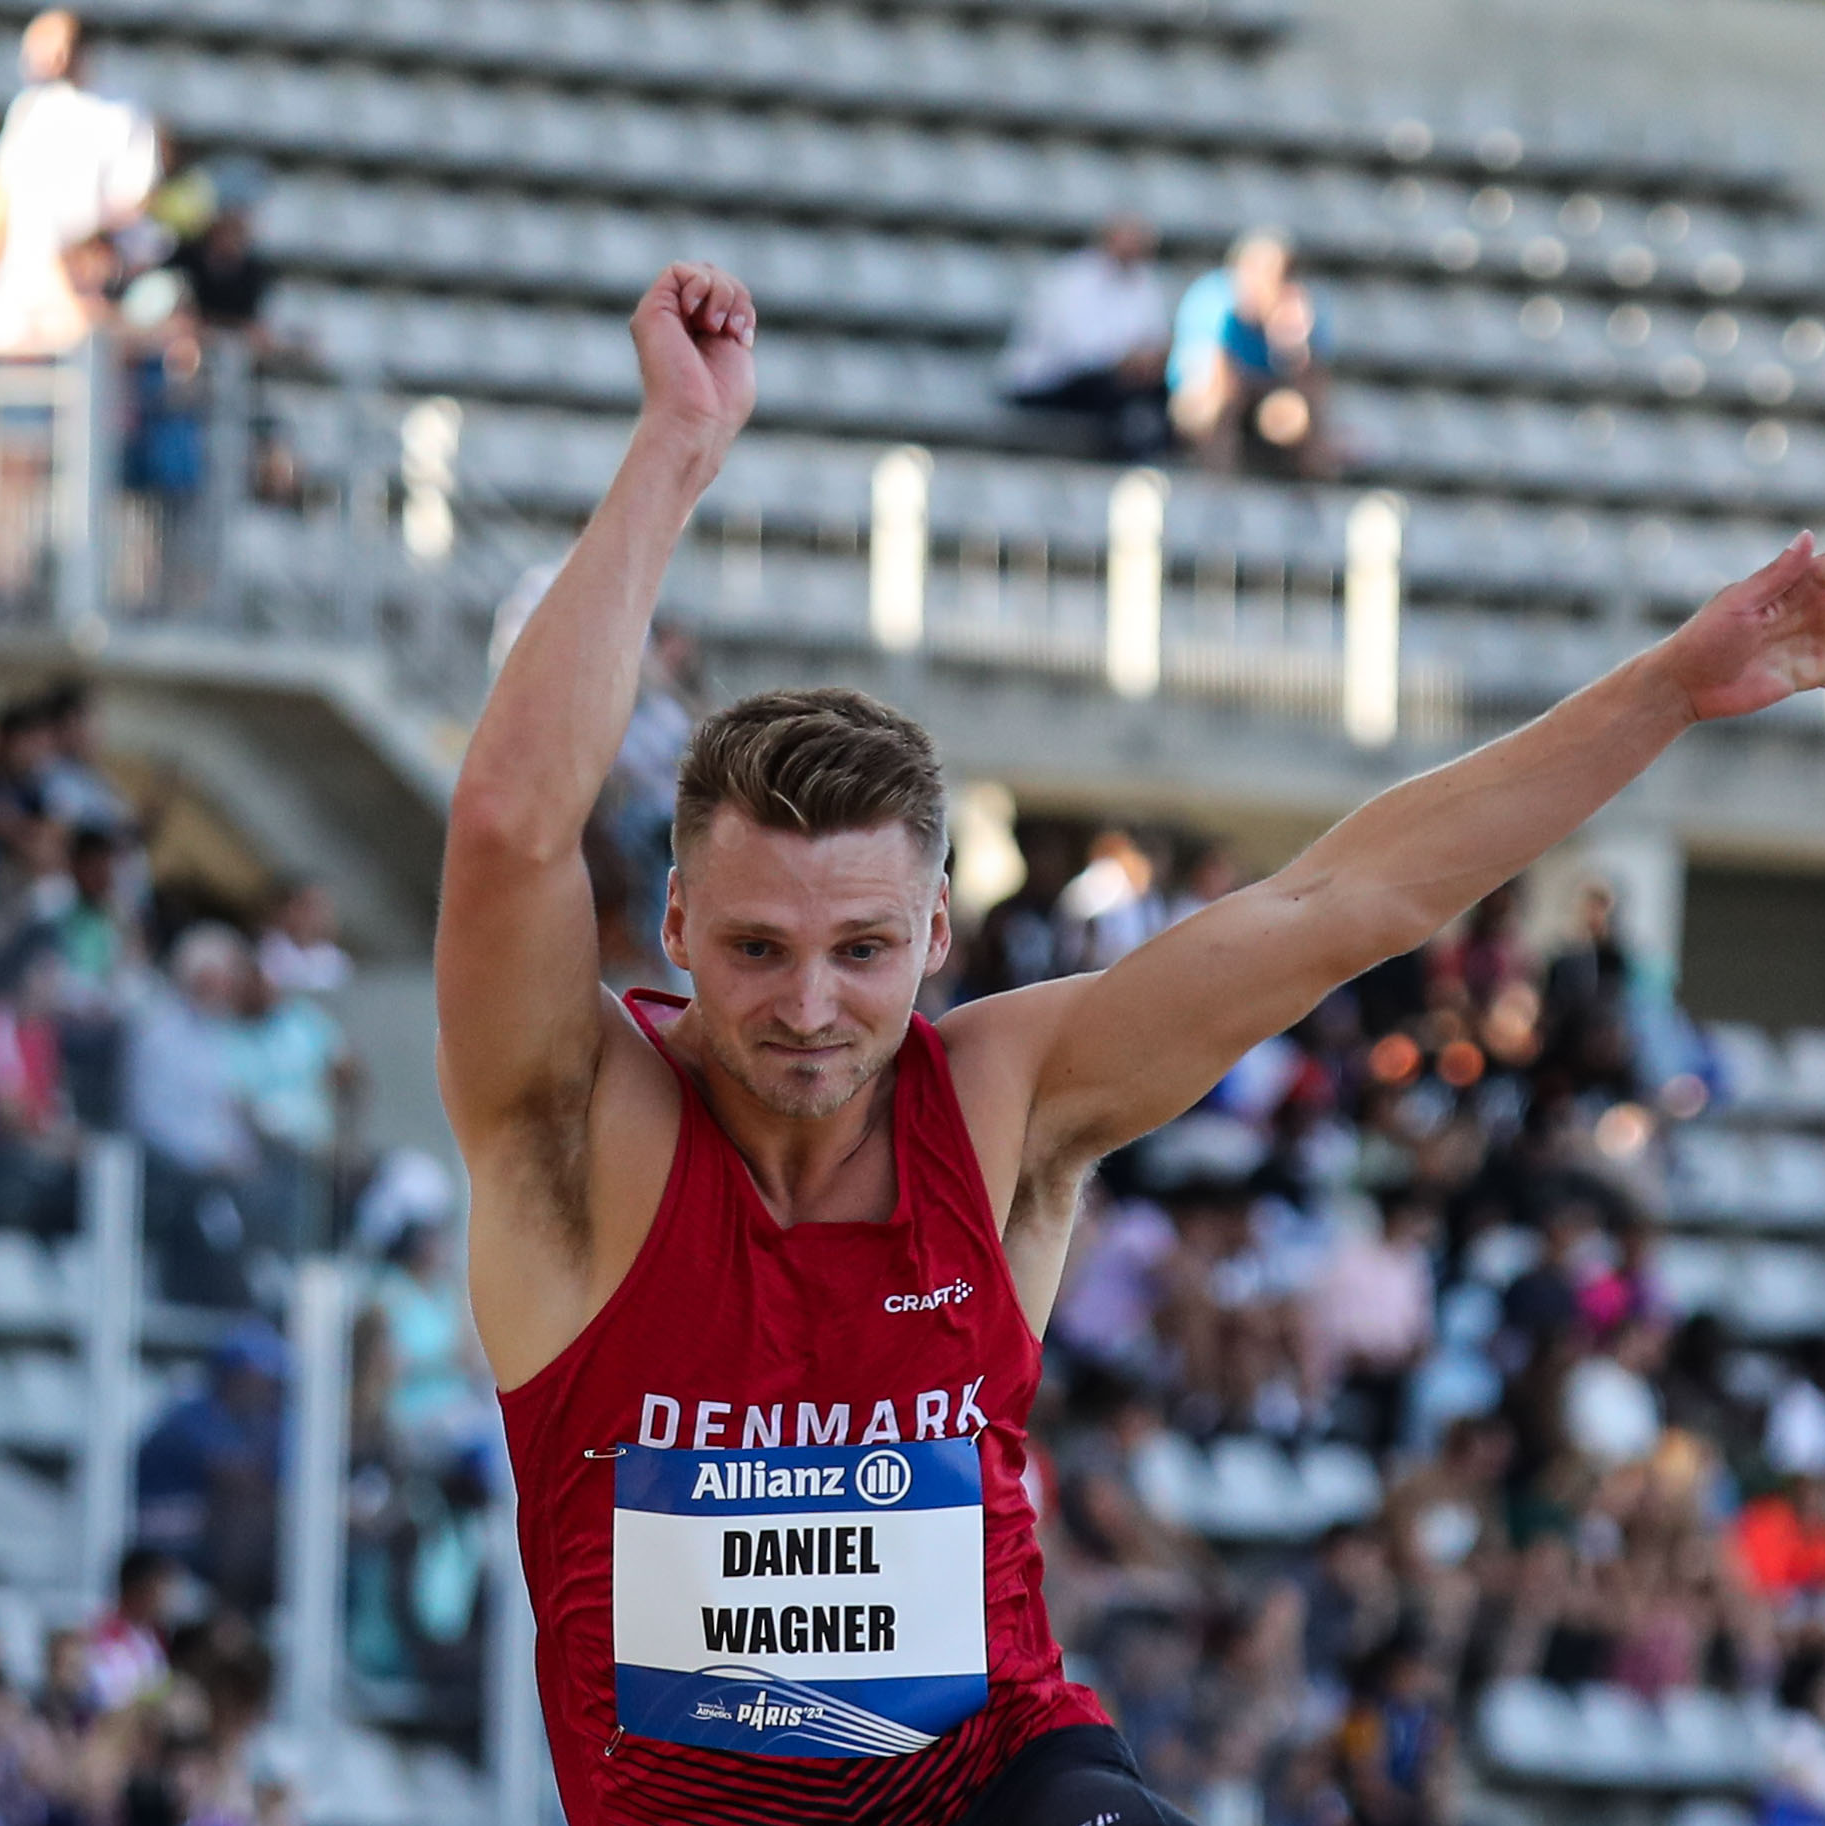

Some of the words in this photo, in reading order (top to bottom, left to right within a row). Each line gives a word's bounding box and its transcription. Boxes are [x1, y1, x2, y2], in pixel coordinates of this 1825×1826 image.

[884, 1285, 955, 1313] CRAFT
[637, 1375, 989, 1450] DENMARK
[691, 1459, 846, 1500] Allianz
[722, 1526, 881, 1578] DANIEL
[701, 1604, 896, 1655] WAGNER
